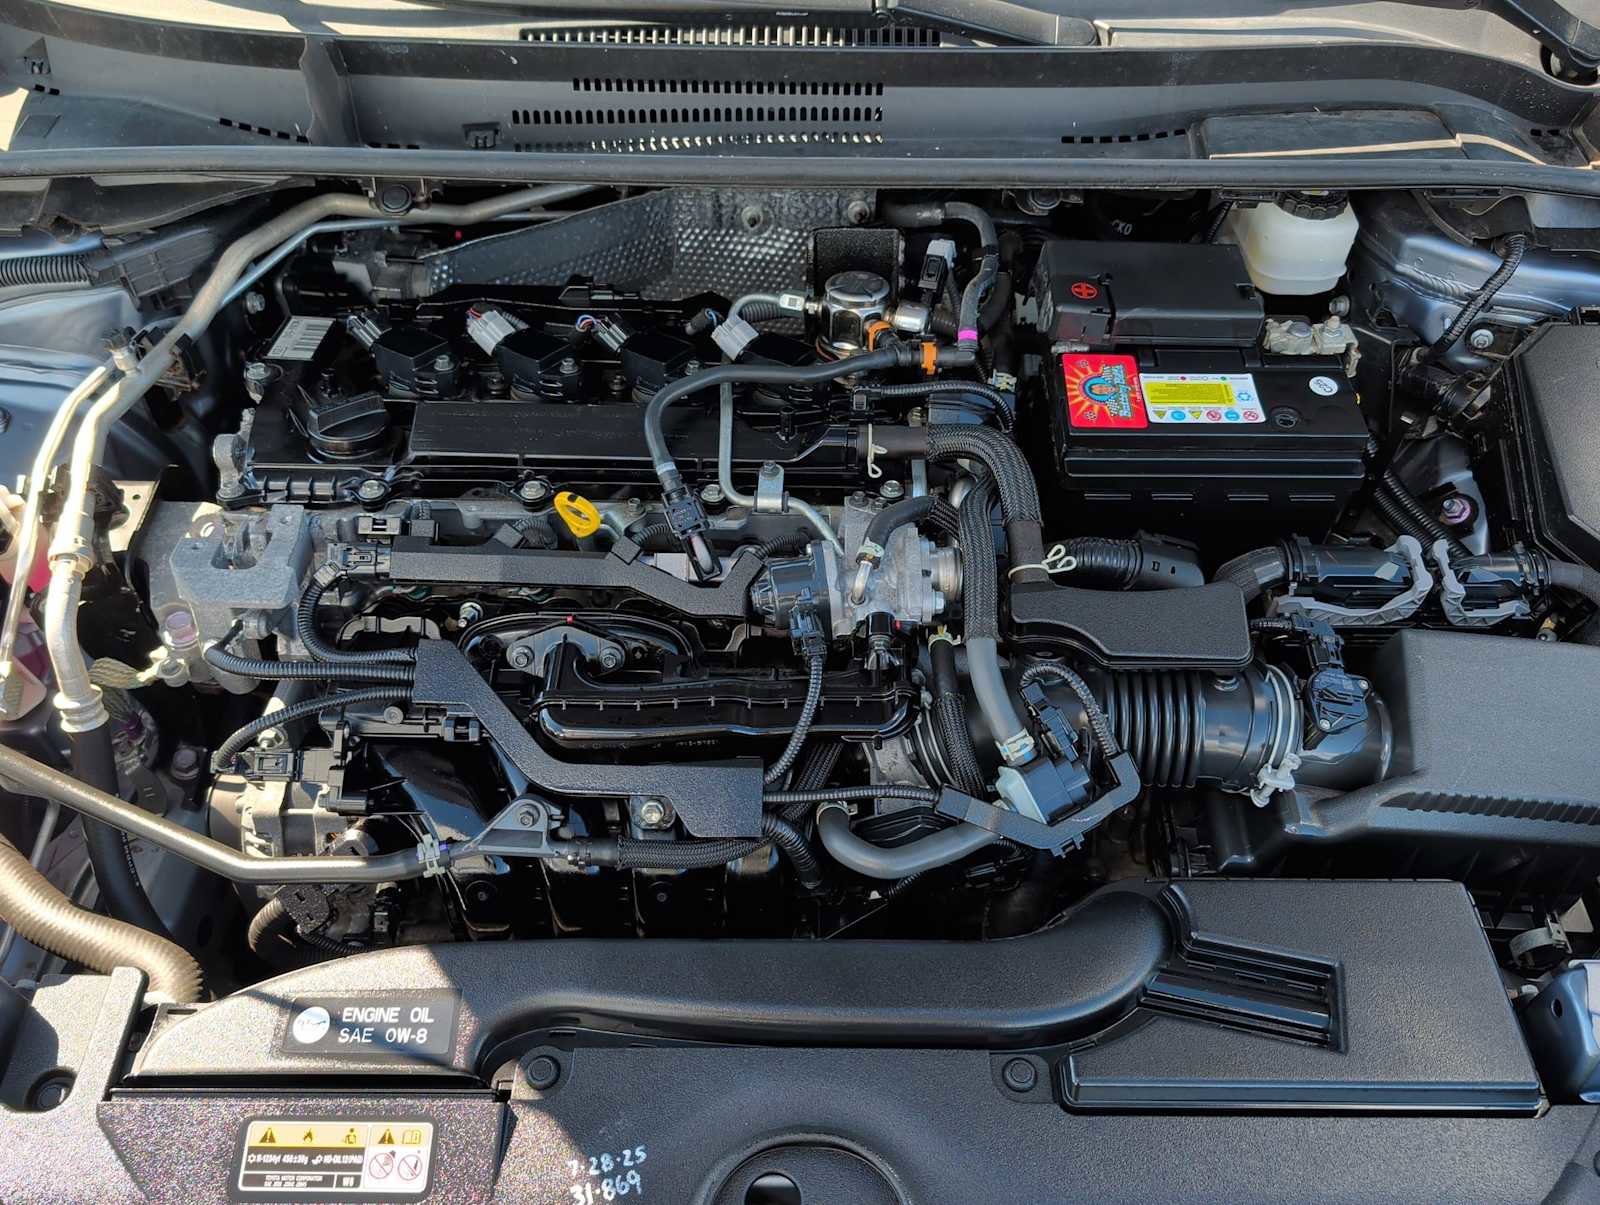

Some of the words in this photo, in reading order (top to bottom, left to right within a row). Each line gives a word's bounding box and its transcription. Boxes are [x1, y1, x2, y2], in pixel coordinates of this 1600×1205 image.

[342, 1006, 401, 1023] ENGINE
[410, 1007, 435, 1023] OIL
[337, 1027, 375, 1044] SAE
[385, 1027, 428, 1044] 0W-8
